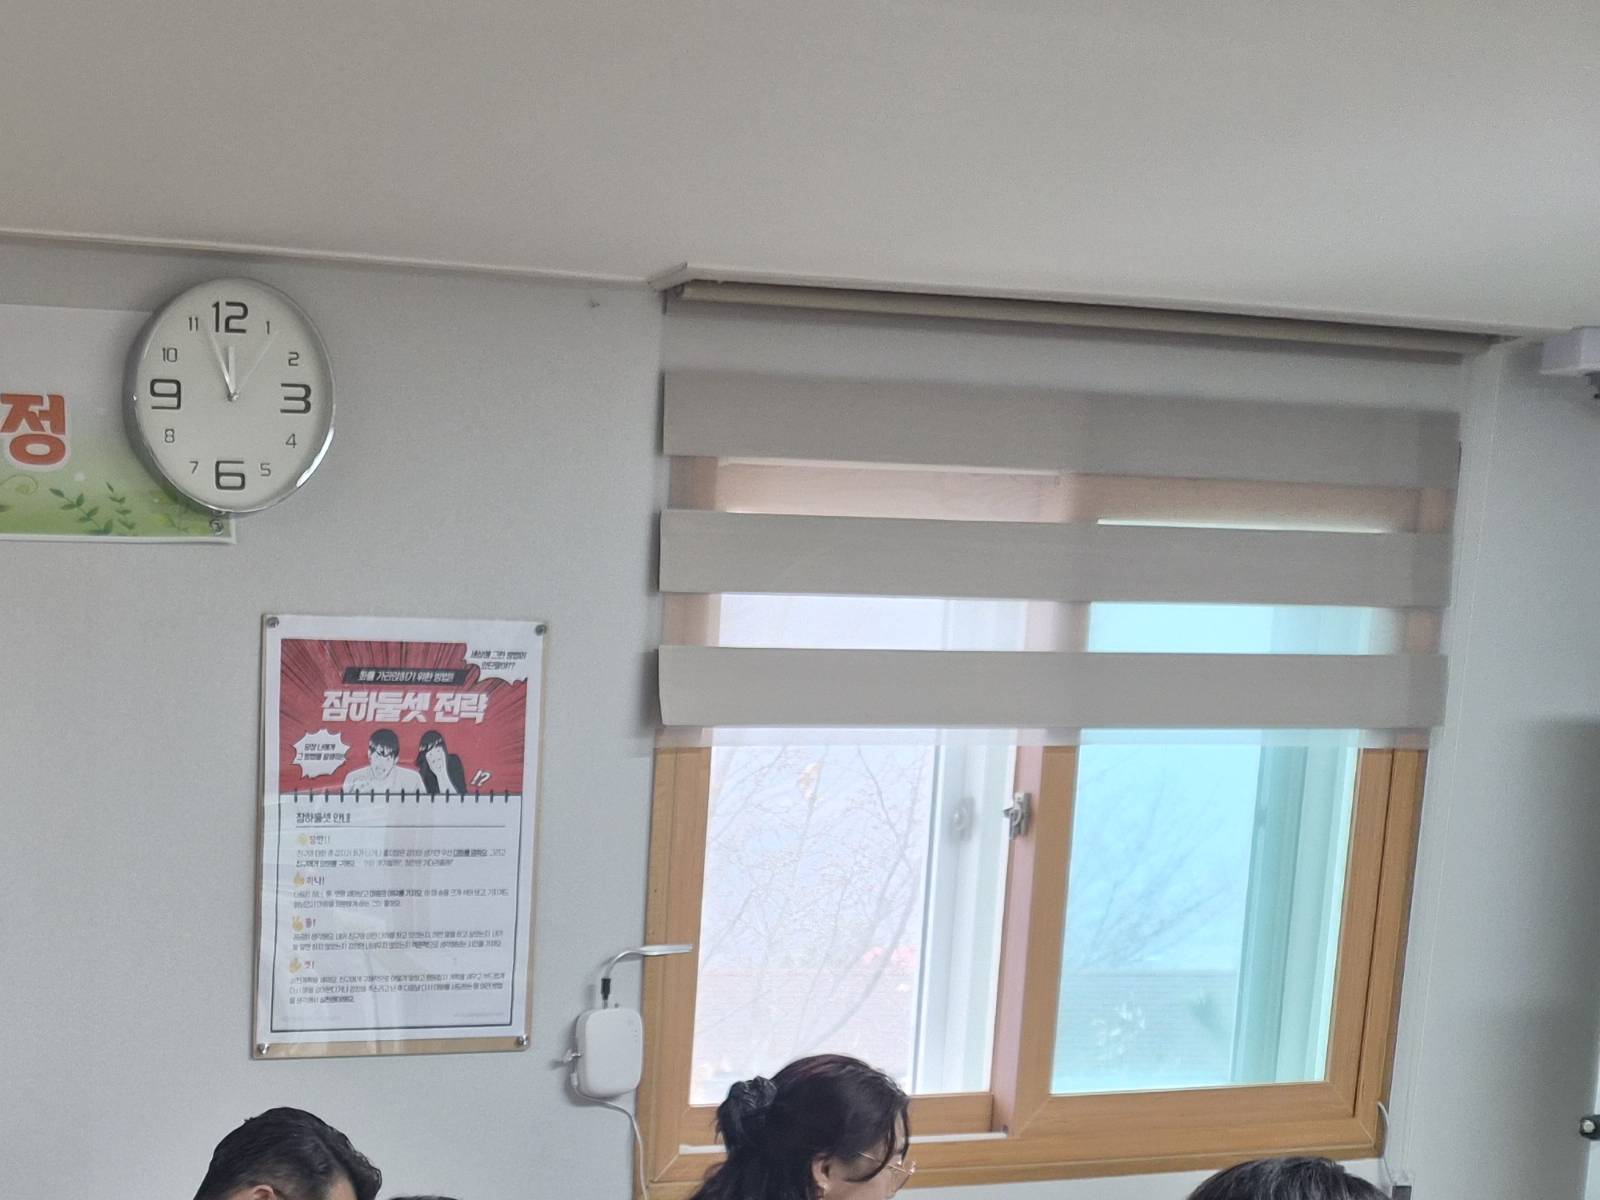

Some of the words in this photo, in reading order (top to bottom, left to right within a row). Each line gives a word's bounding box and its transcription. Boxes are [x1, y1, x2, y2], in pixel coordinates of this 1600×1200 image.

[188, 317, 199, 332] 11
[212, 301, 249, 334] 12
[266, 321, 271, 335] 1
[162, 348, 178, 362] 10
[288, 352, 300, 366] 2
[150, 379, 181, 410] 9
[280, 383, 311, 414] 3
[164, 429, 175, 443] 8
[285, 433, 297, 449] 4
[189, 461, 199, 475] 7
[260, 463, 271, 477] 5
[215, 460, 246, 491] 6
[358, 670, 376, 681] 화를
[417, 671, 433, 682] 위한
[321, 690, 431, 723] 잠하둘셋
[434, 692, 490, 724] 전략
